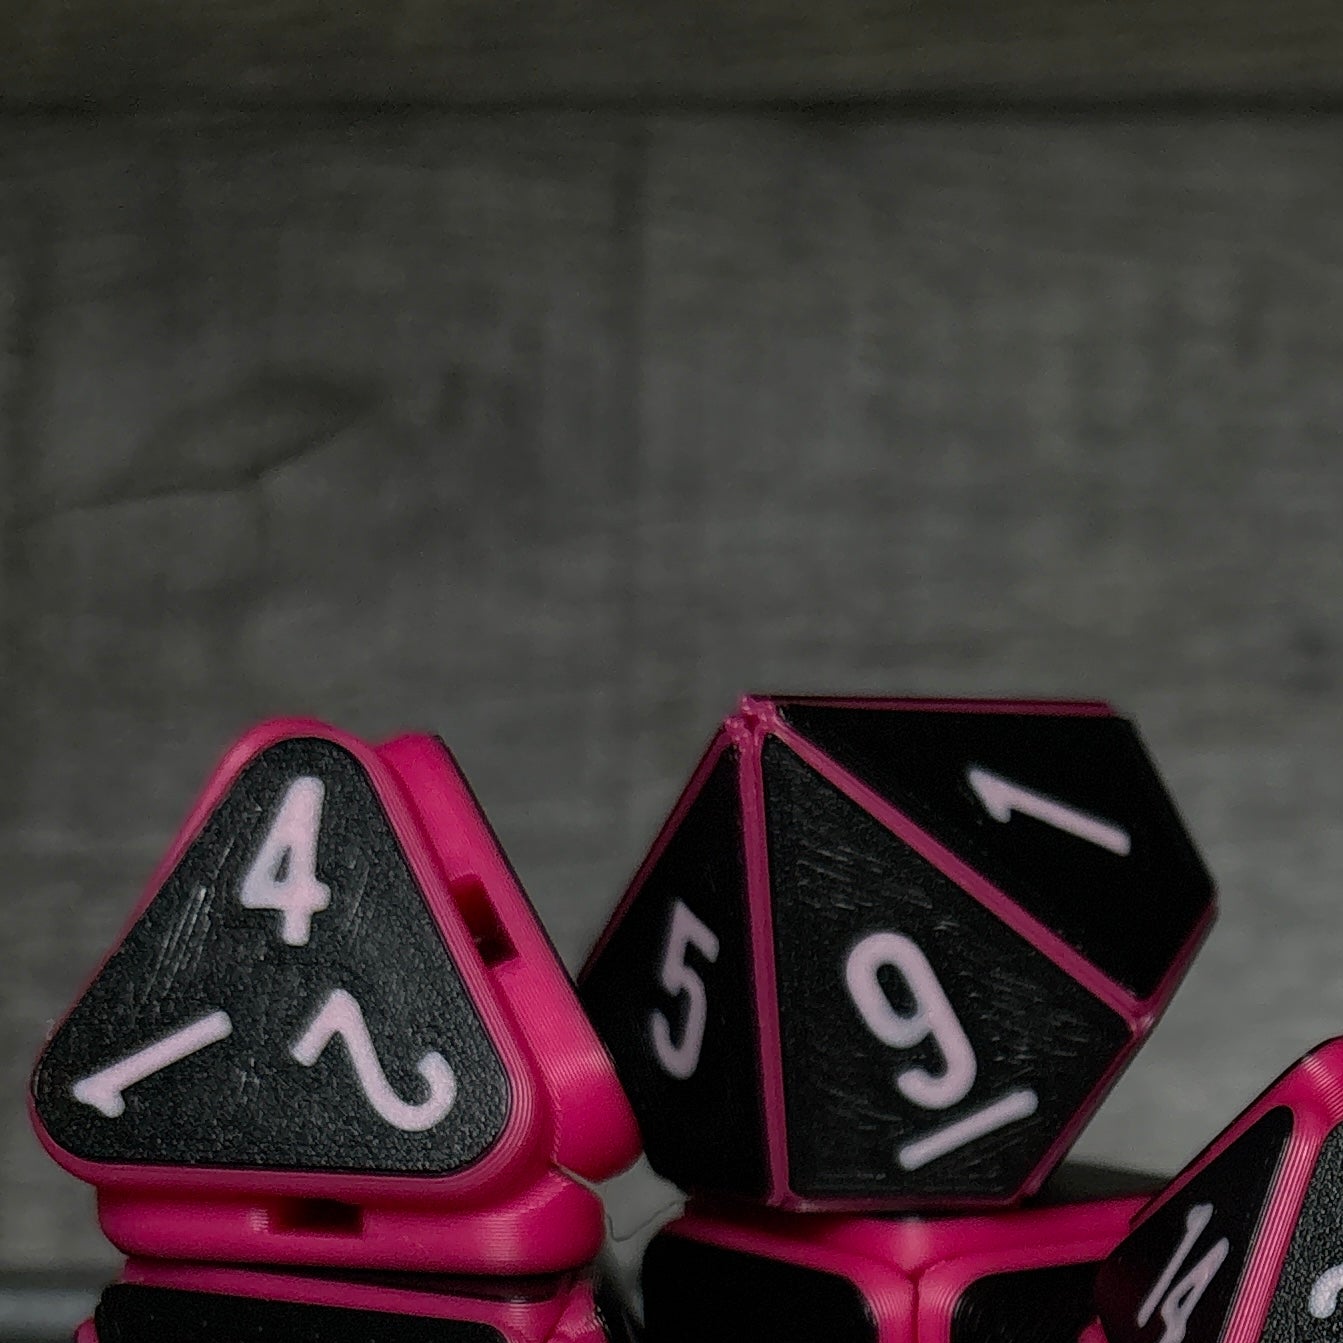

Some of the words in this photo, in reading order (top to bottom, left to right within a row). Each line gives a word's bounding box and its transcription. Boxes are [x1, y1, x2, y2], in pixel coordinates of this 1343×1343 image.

[235, 774, 332, 947] 4
[968, 768, 1131, 855] 1
[71, 1009, 233, 1119] 1
[286, 987, 462, 1134] 2
[650, 900, 720, 1079] 5
[844, 931, 1039, 1171] 9
